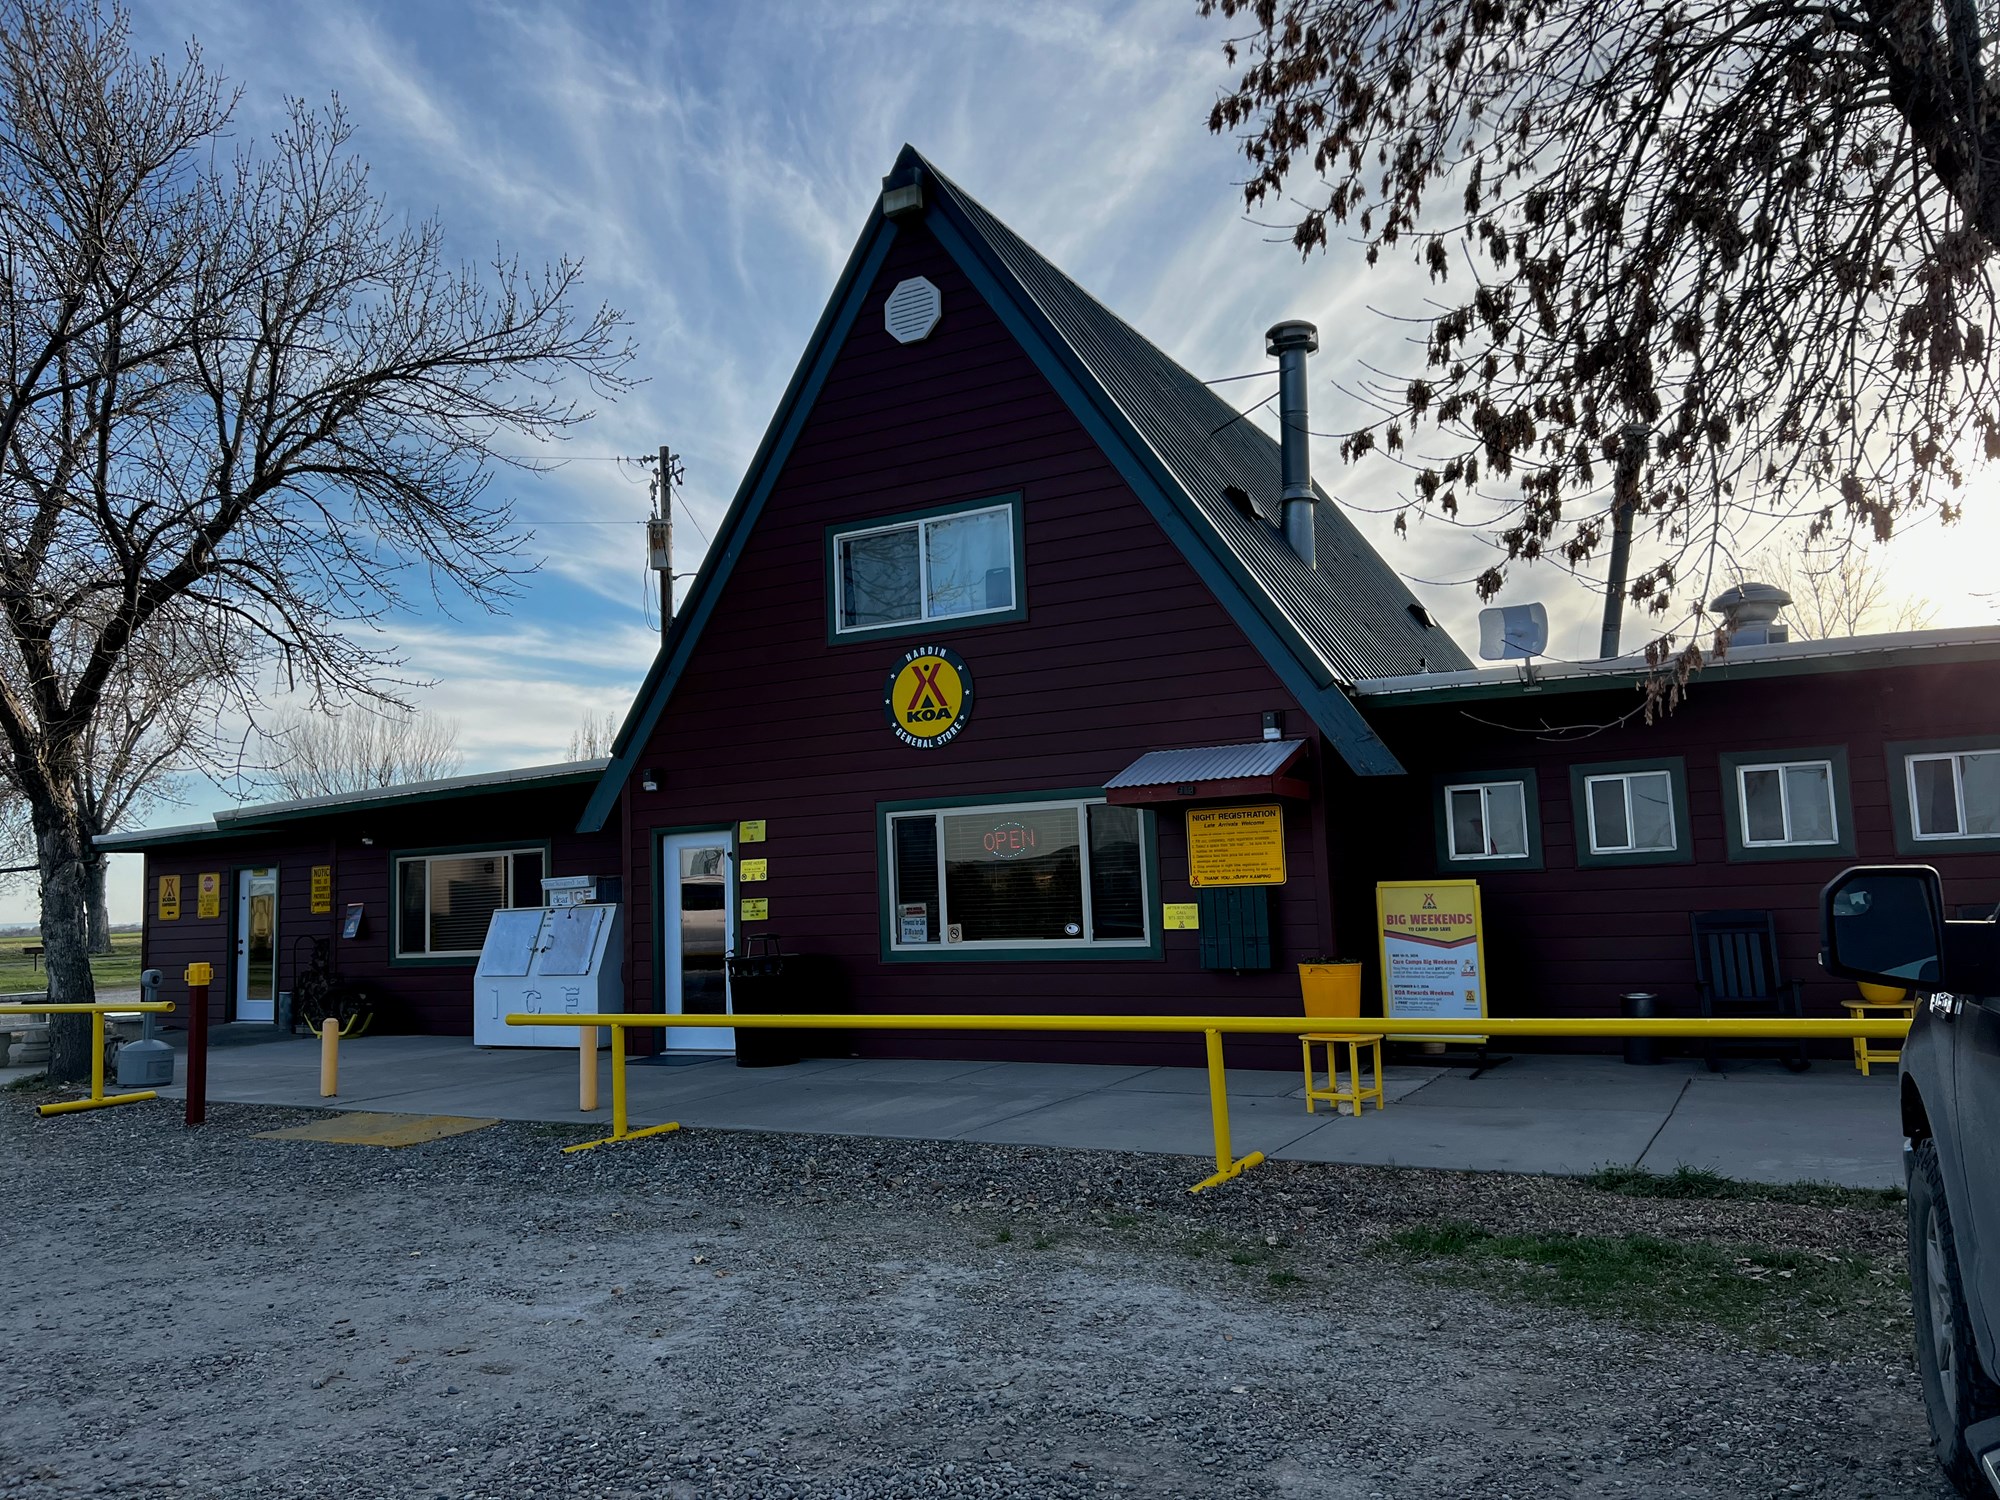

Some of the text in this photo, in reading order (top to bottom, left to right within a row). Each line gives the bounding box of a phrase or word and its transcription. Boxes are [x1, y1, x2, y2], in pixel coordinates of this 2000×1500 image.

[905, 646, 947, 662] HARDIN
[907, 707, 952, 723] KOA
[895, 721, 962, 748] GENERAL STORE
[1192, 810, 1276, 822] NIGHT REGISTRATION
[984, 828, 1035, 851] OPEN
[314, 868, 330, 878] NOTIC
[553, 895, 568, 904] clear
[569, 890, 592, 904] ICE
[1386, 914, 1473, 925] BIG WEEKENDS
